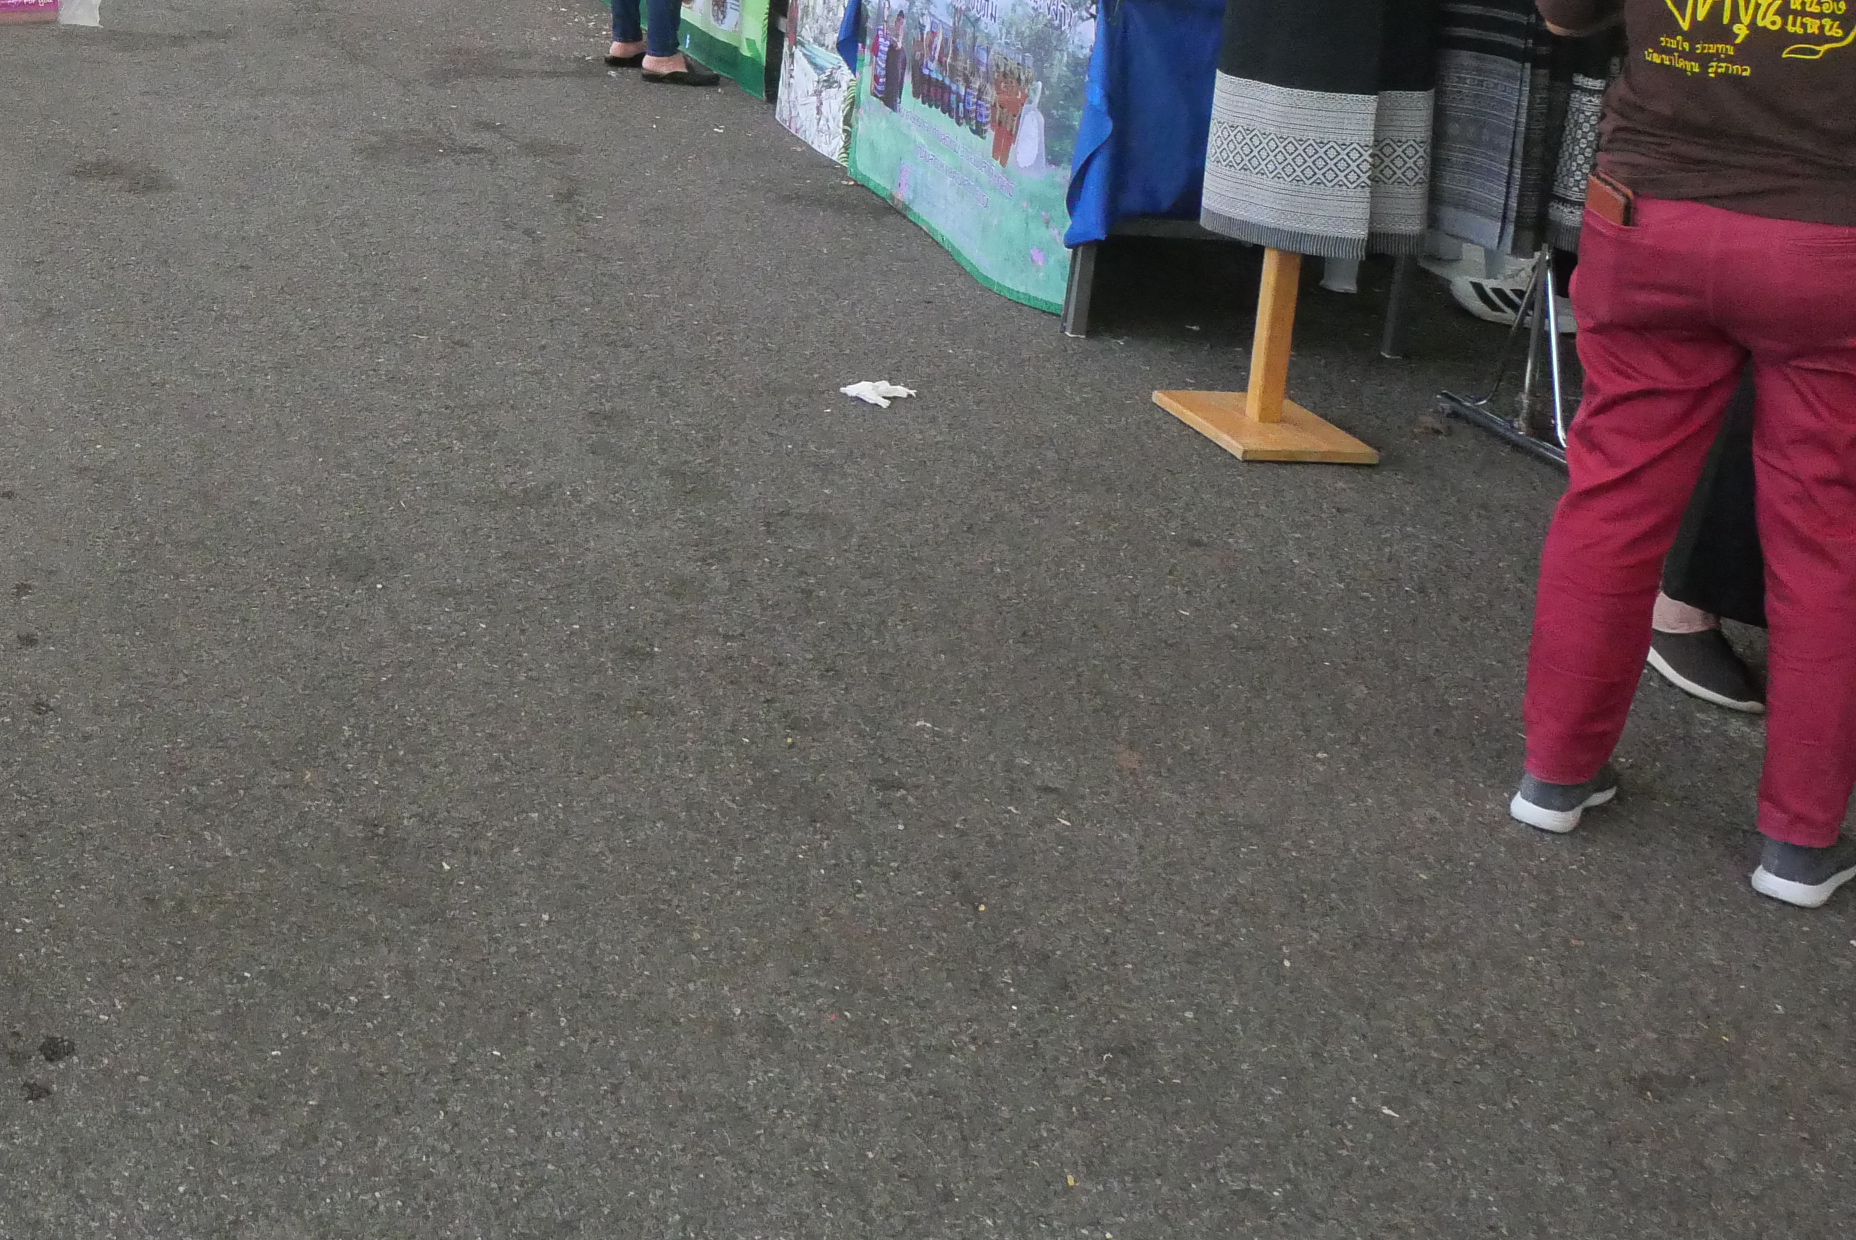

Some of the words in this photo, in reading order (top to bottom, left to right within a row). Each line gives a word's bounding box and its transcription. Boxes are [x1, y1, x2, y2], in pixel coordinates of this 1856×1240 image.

[1786, 15, 1843, 38] แหน
[1660, 33, 1690, 52] ร่วมใจ
